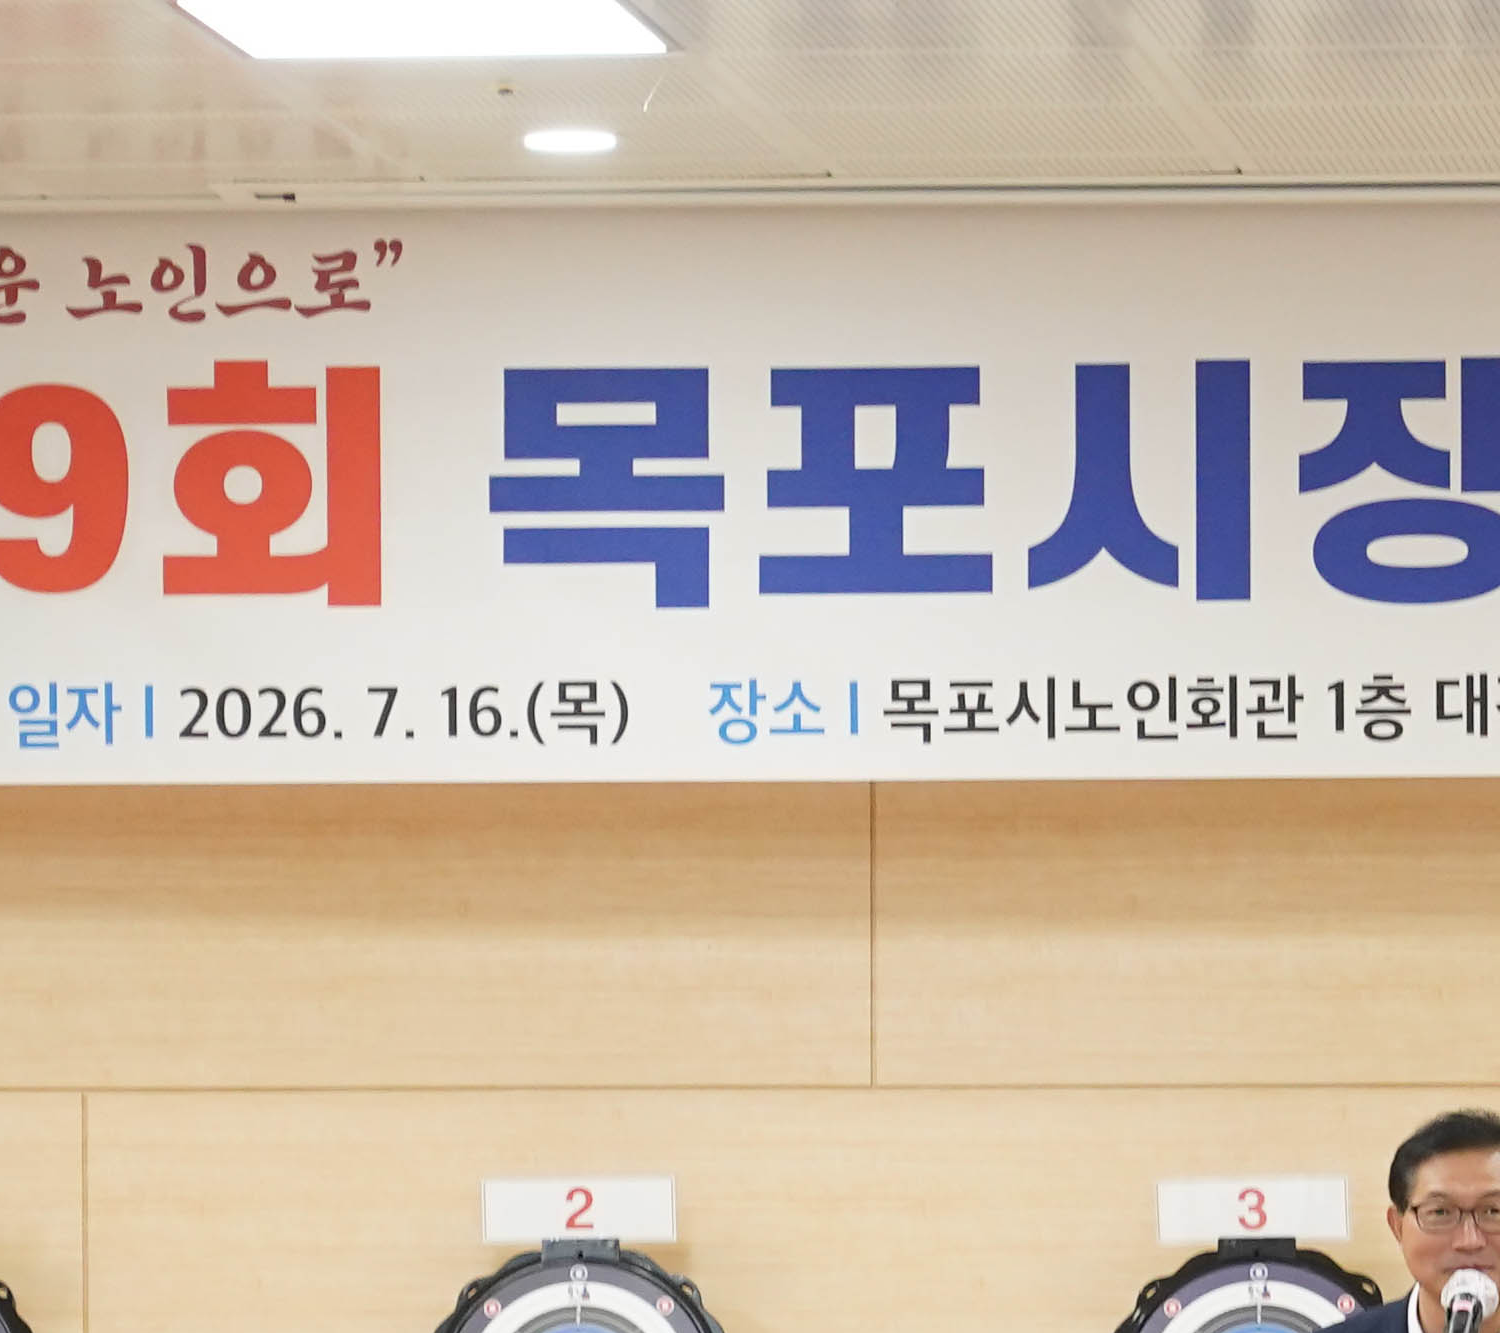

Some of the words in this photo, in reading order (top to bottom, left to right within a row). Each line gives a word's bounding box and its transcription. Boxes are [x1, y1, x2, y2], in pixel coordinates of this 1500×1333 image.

[8, 681, 122, 749] 일자
[179, 686, 343, 740] 2026.
[367, 686, 415, 739] 7.
[440, 680, 629, 746] 16.(목)
[709, 678, 825, 745] 장소
[883, 674, 1305, 745] 목포시노인회관
[1327, 674, 1412, 742] 1층
[565, 1186, 594, 1229] 2
[1238, 1188, 1268, 1230] 3
